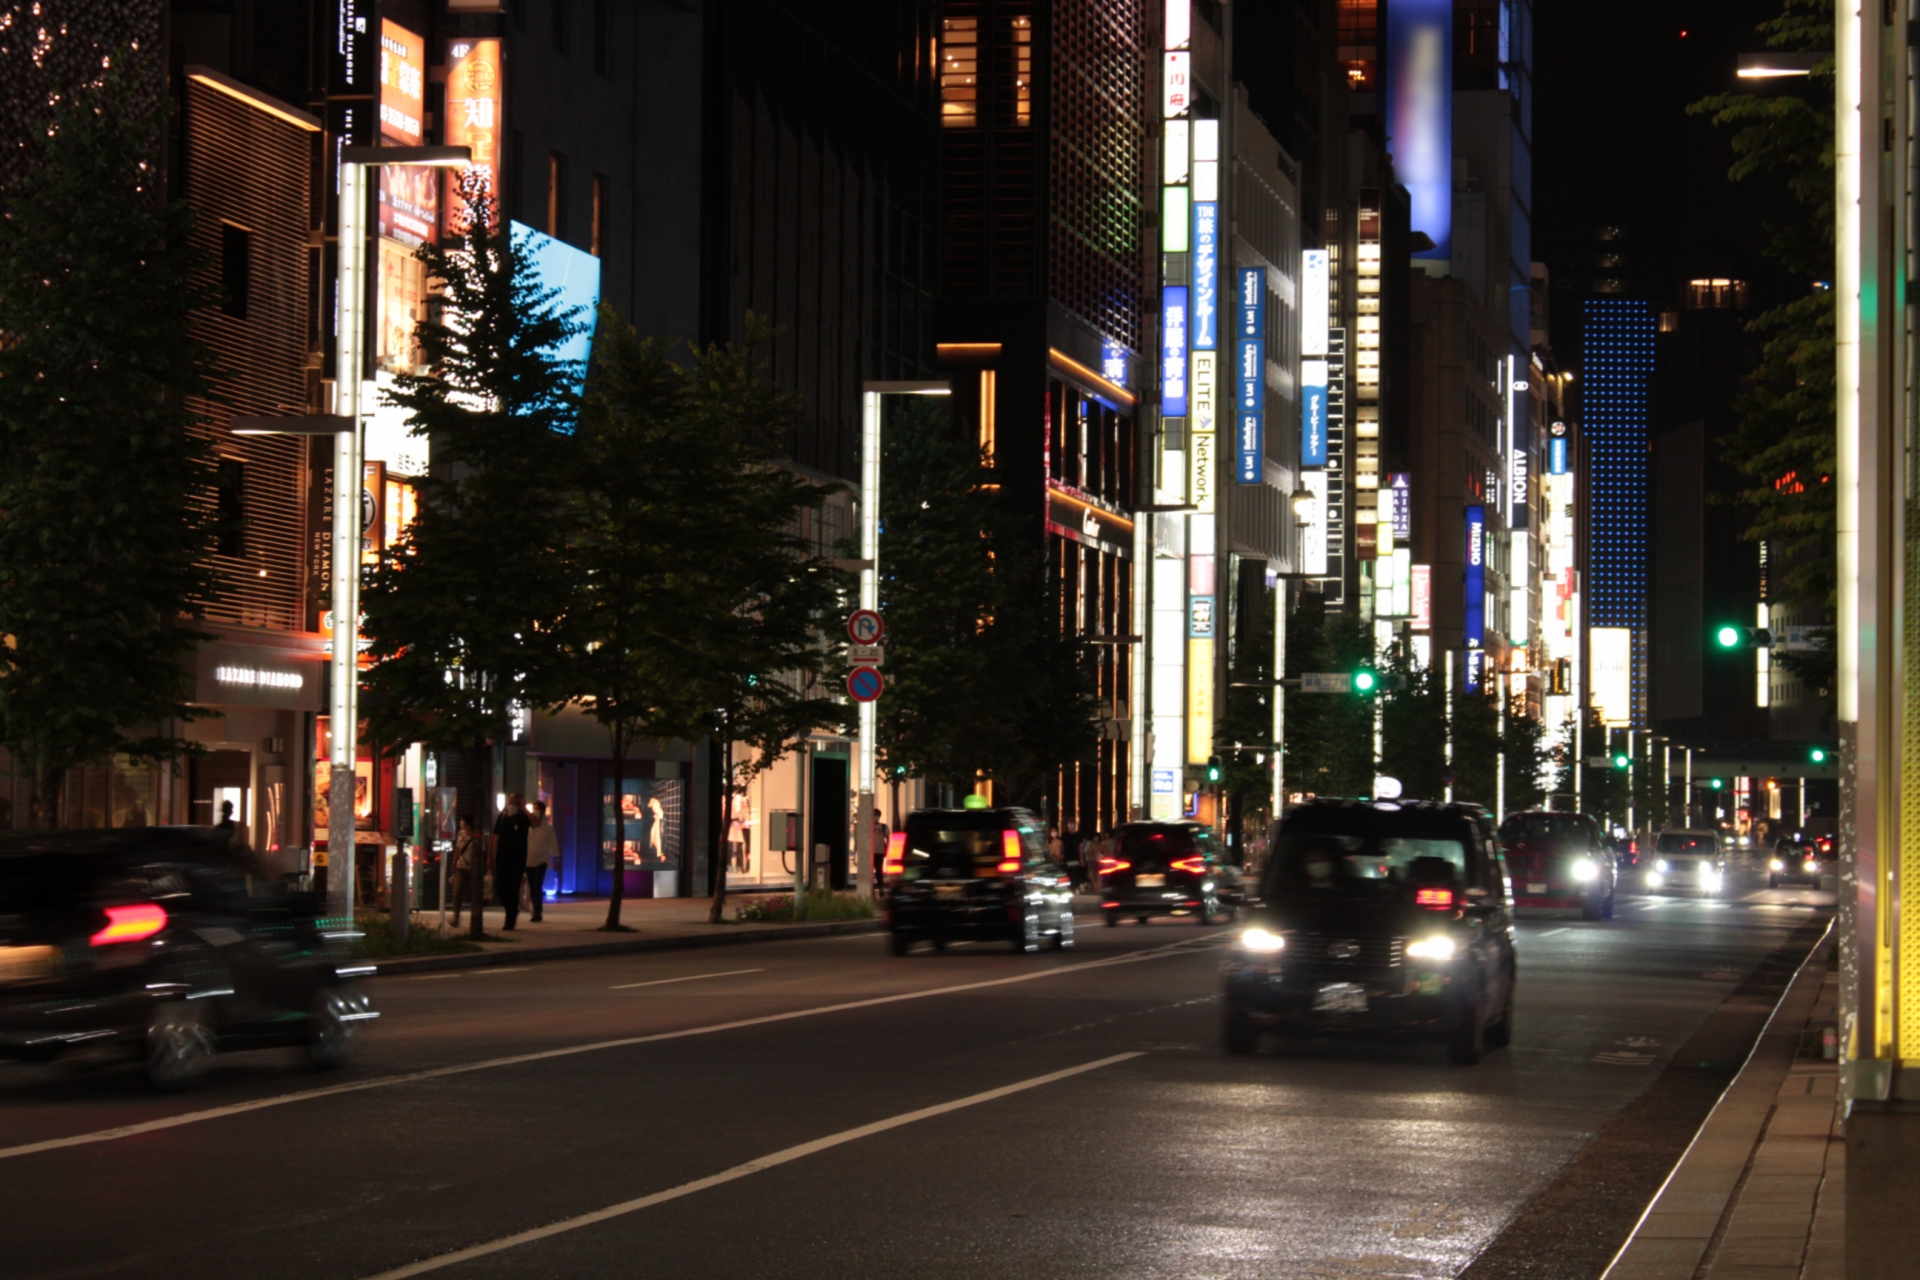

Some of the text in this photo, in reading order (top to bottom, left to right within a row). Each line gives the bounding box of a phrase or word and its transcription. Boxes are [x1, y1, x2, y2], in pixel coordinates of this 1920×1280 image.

[346, 34, 354, 84] DIAMOND
[451, 44, 469, 58] 4F
[1196, 358, 1211, 411] ELITE
[1196, 435, 1210, 504] Network
[1513, 448, 1527, 505] ALBION
[323, 468, 334, 522] LAZARE
[1400, 490, 1408, 531] GINZA
[312, 531, 321, 576] NEW YORK
[321, 531, 332, 592] DIAMON
[1470, 522, 1482, 566] MIZUHO
[870, 648, 879, 656] 20
[219, 666, 304, 689] LAZARE DIAMOND
